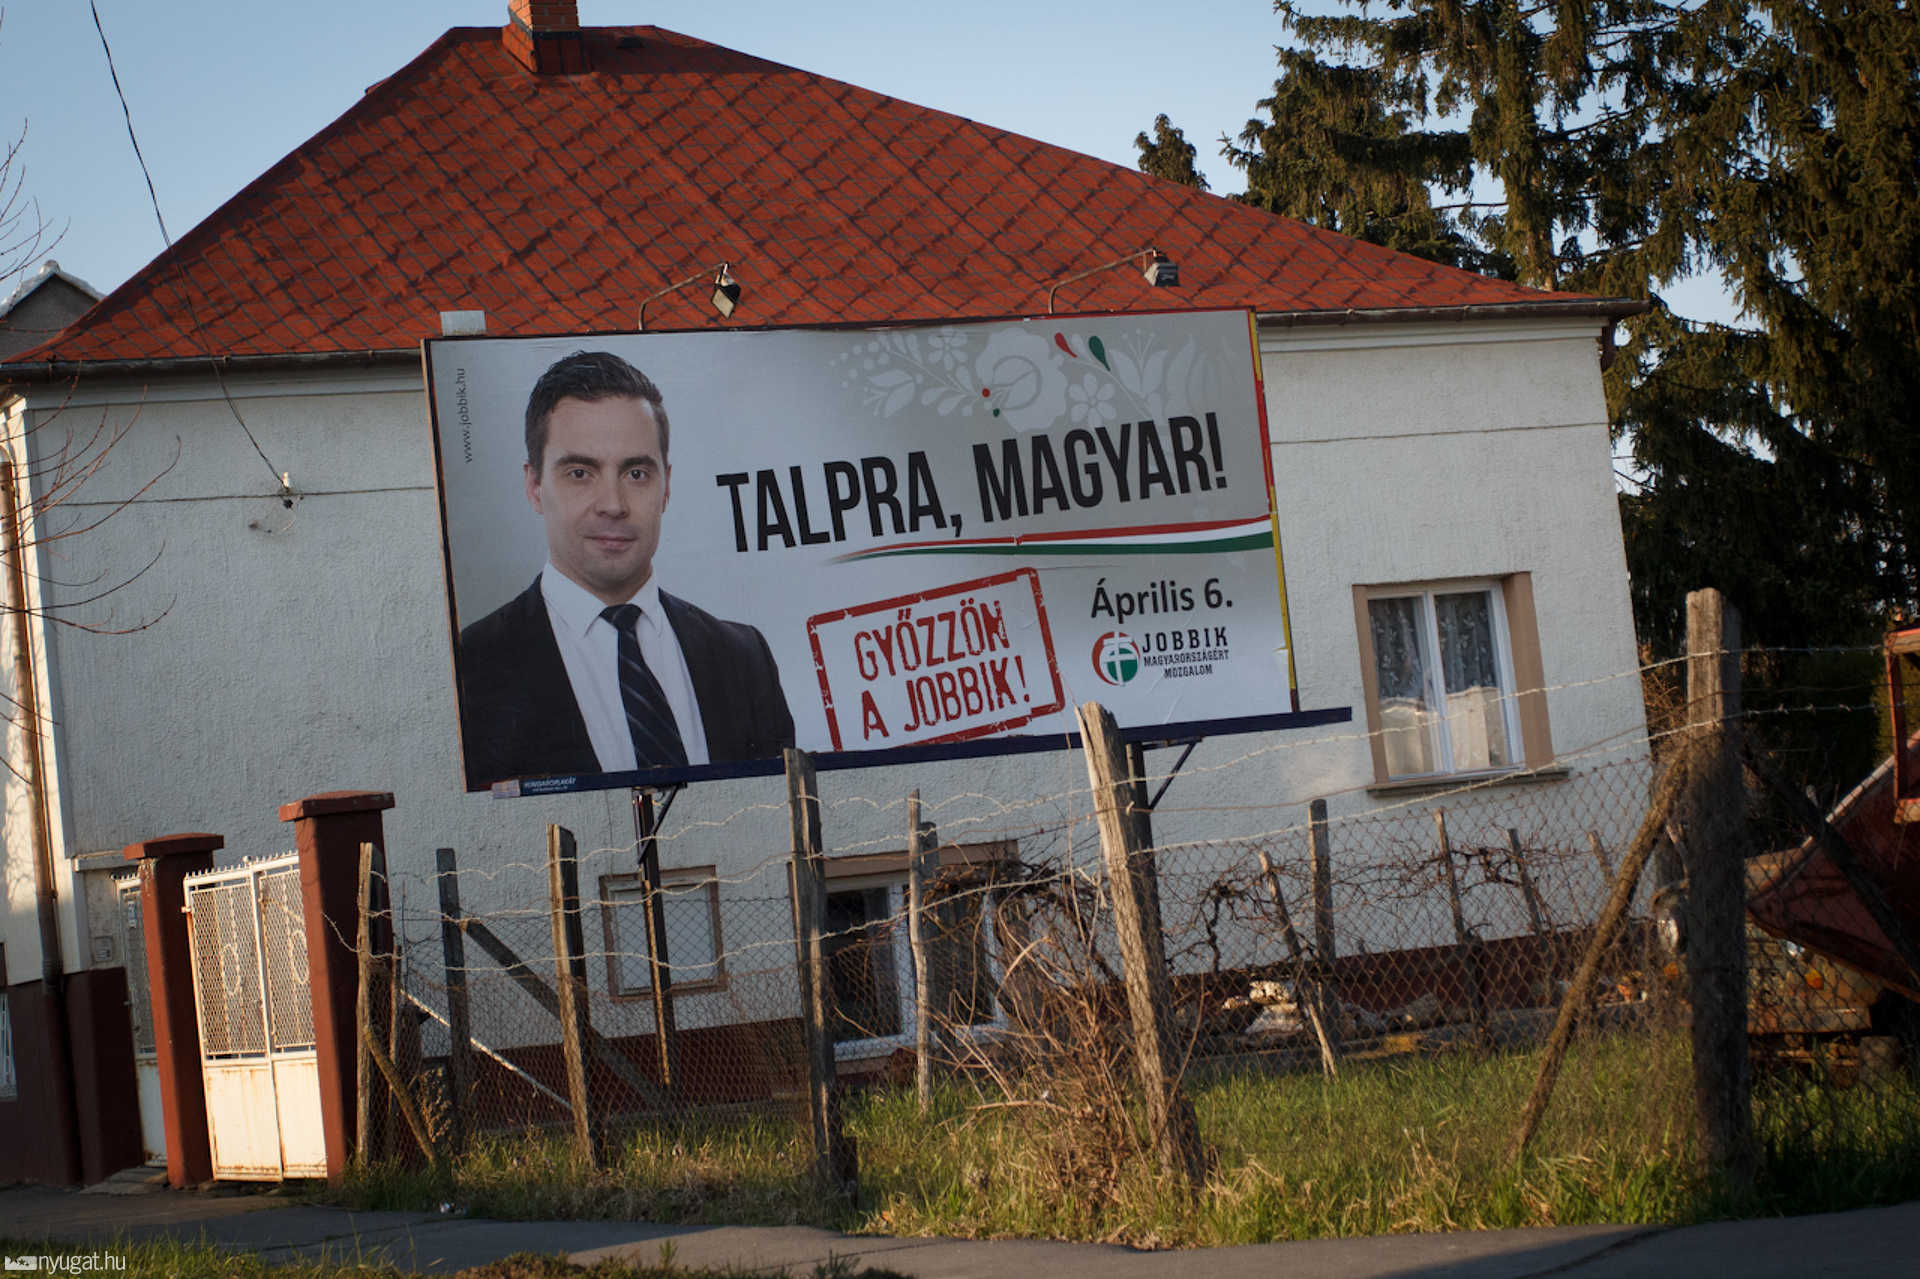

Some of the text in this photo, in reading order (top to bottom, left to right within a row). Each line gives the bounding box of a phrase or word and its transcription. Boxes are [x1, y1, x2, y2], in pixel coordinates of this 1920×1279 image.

[456, 368, 473, 464] www.jobbik.hu
[716, 412, 1228, 553] TALPRA, MAGYAR!
[1091, 577, 1233, 624] Április 6.
[854, 597, 1010, 681] GYŐZZÖN
[1142, 626, 1228, 653] JOBBIK
[1143, 648, 1229, 667] MAGYARORSZÁGÉRT
[1164, 664, 1213, 679] MOZGALOM
[861, 655, 1031, 741] A JOBBIK!
